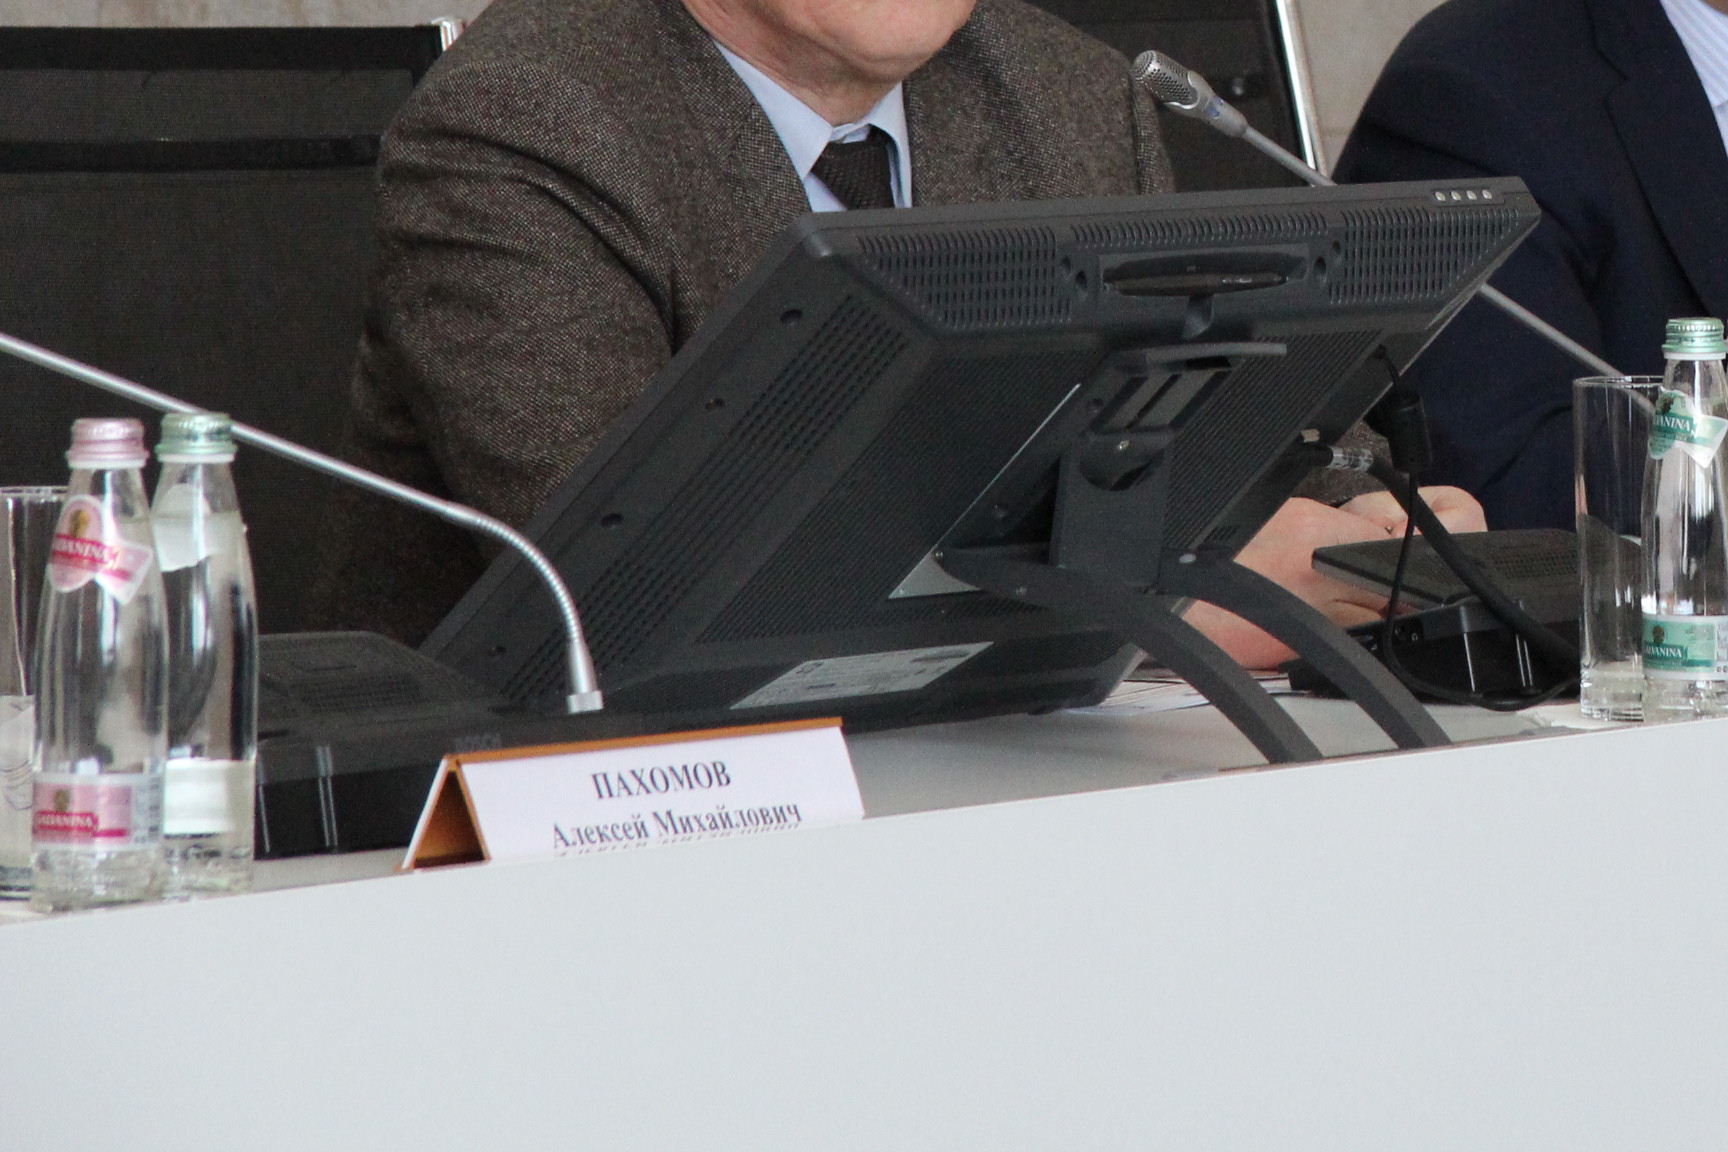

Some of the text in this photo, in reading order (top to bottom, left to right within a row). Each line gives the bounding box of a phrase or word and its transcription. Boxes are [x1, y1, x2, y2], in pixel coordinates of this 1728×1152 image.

[590, 759, 733, 800] ПАХОМОВ
[552, 802, 803, 850] Алексей Михайлович
